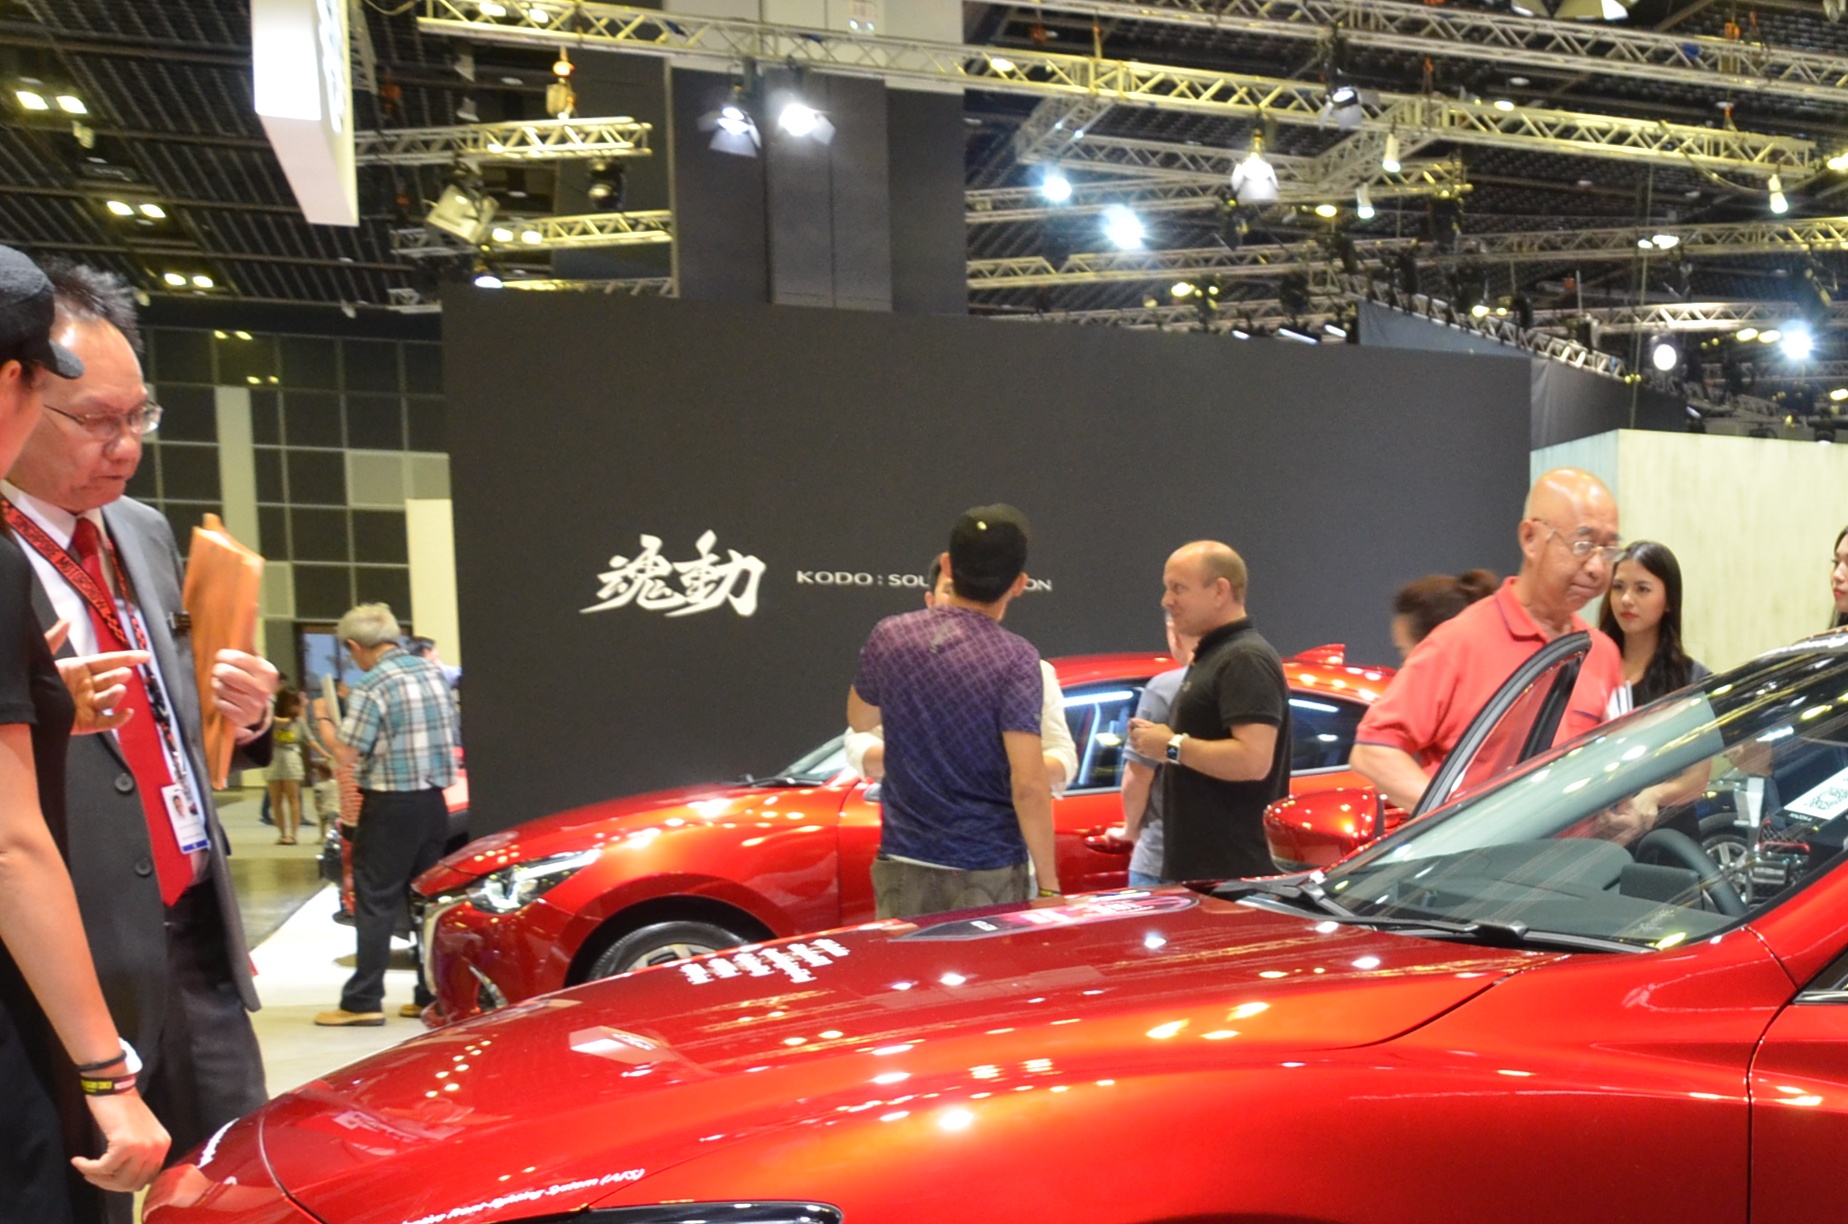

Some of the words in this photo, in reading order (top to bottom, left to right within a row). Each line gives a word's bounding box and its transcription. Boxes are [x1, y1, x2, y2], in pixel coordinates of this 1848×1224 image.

[579, 529, 767, 617] 魂動
[796, 570, 873, 586] KODO
[545, 1178, 599, 1196] System
